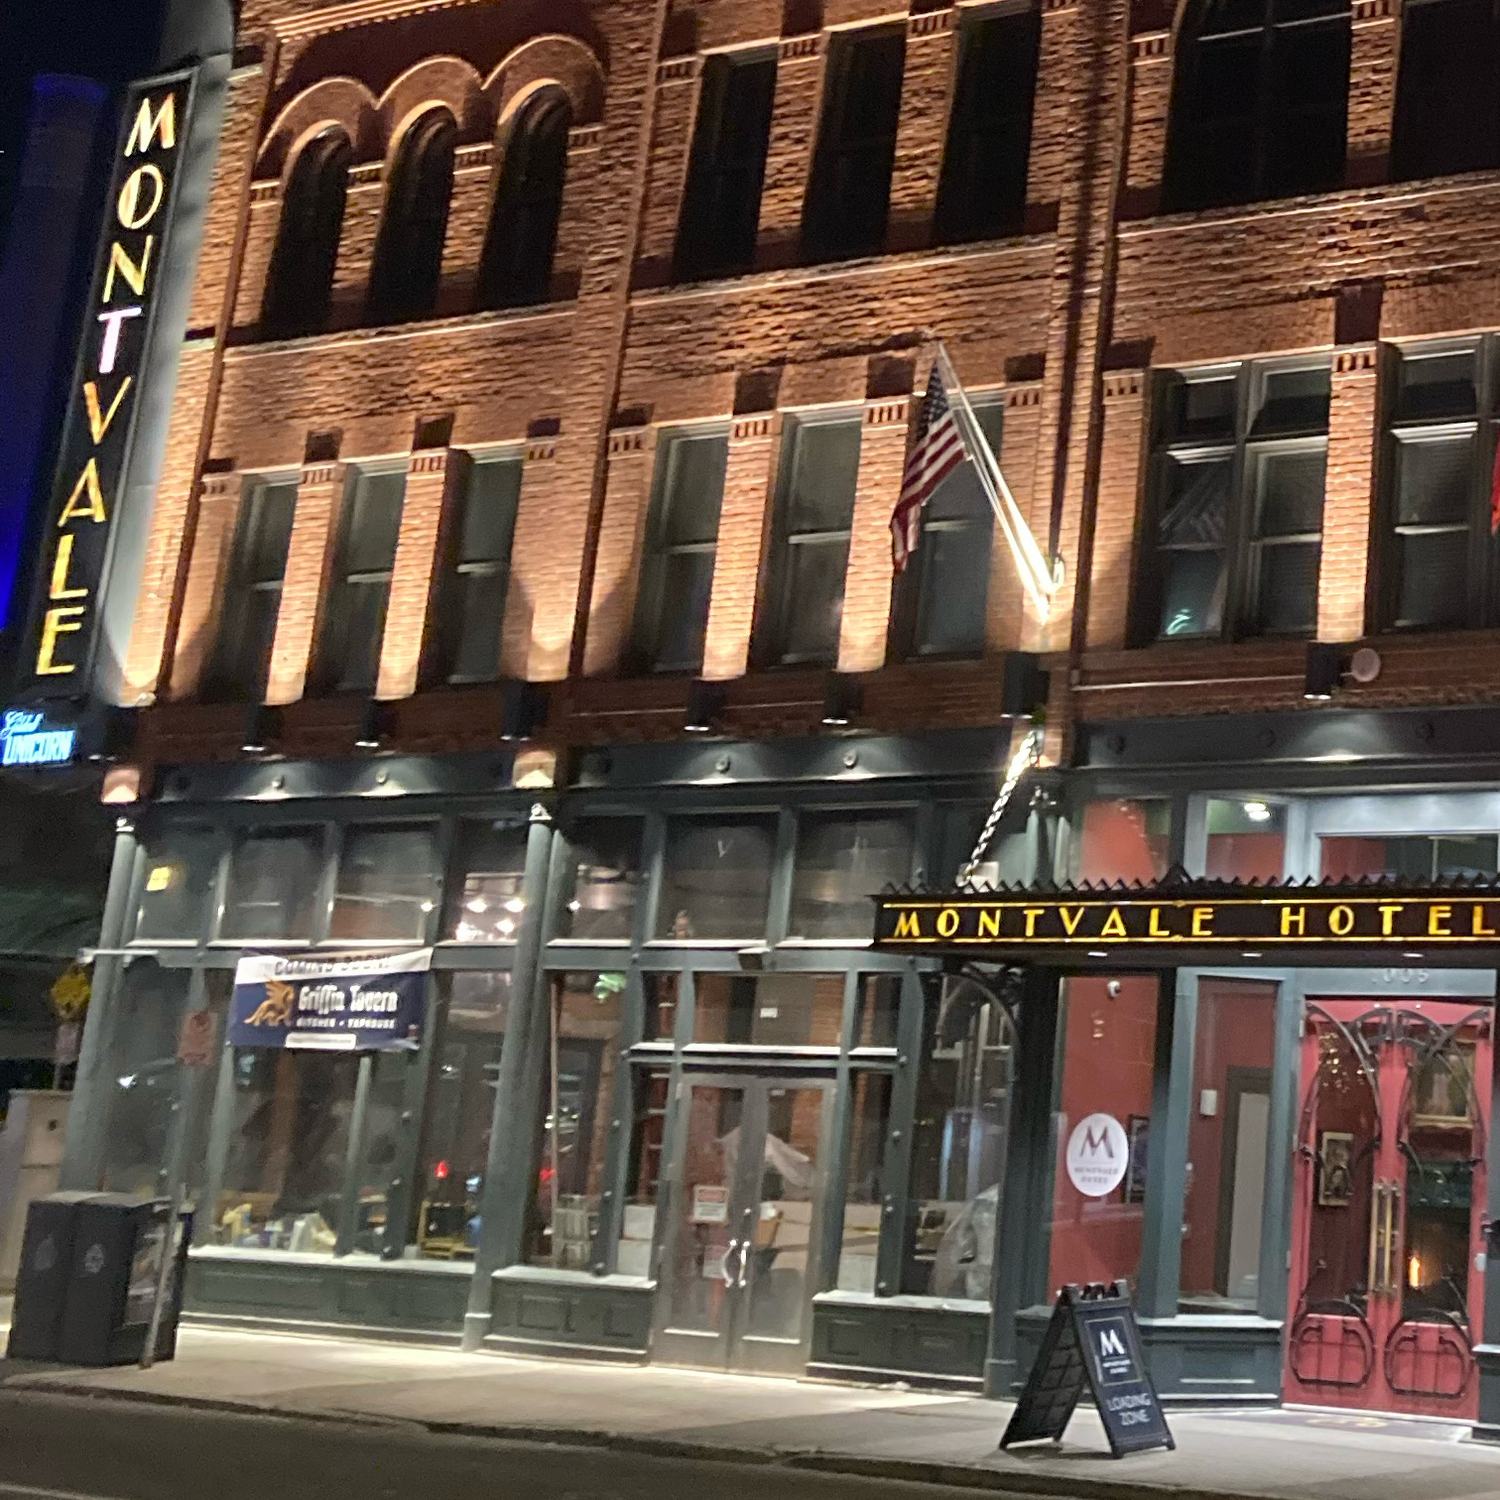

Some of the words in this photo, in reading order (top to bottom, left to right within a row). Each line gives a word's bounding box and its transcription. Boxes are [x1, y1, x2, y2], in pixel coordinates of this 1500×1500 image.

[36, 92, 175, 676] MONTVALE
[3, 730, 75, 764] UNICORN
[893, 906, 1214, 938] MONTVALE
[1280, 905, 1496, 937] HOTEL
[299, 984, 345, 1015] Griffin
[349, 985, 398, 1012] Tavern
[1080, 1125, 1114, 1158] M
[1100, 1329, 1125, 1357] M
[1106, 1393, 1151, 1412] LOADING
[1119, 1409, 1151, 1426] ZONE
